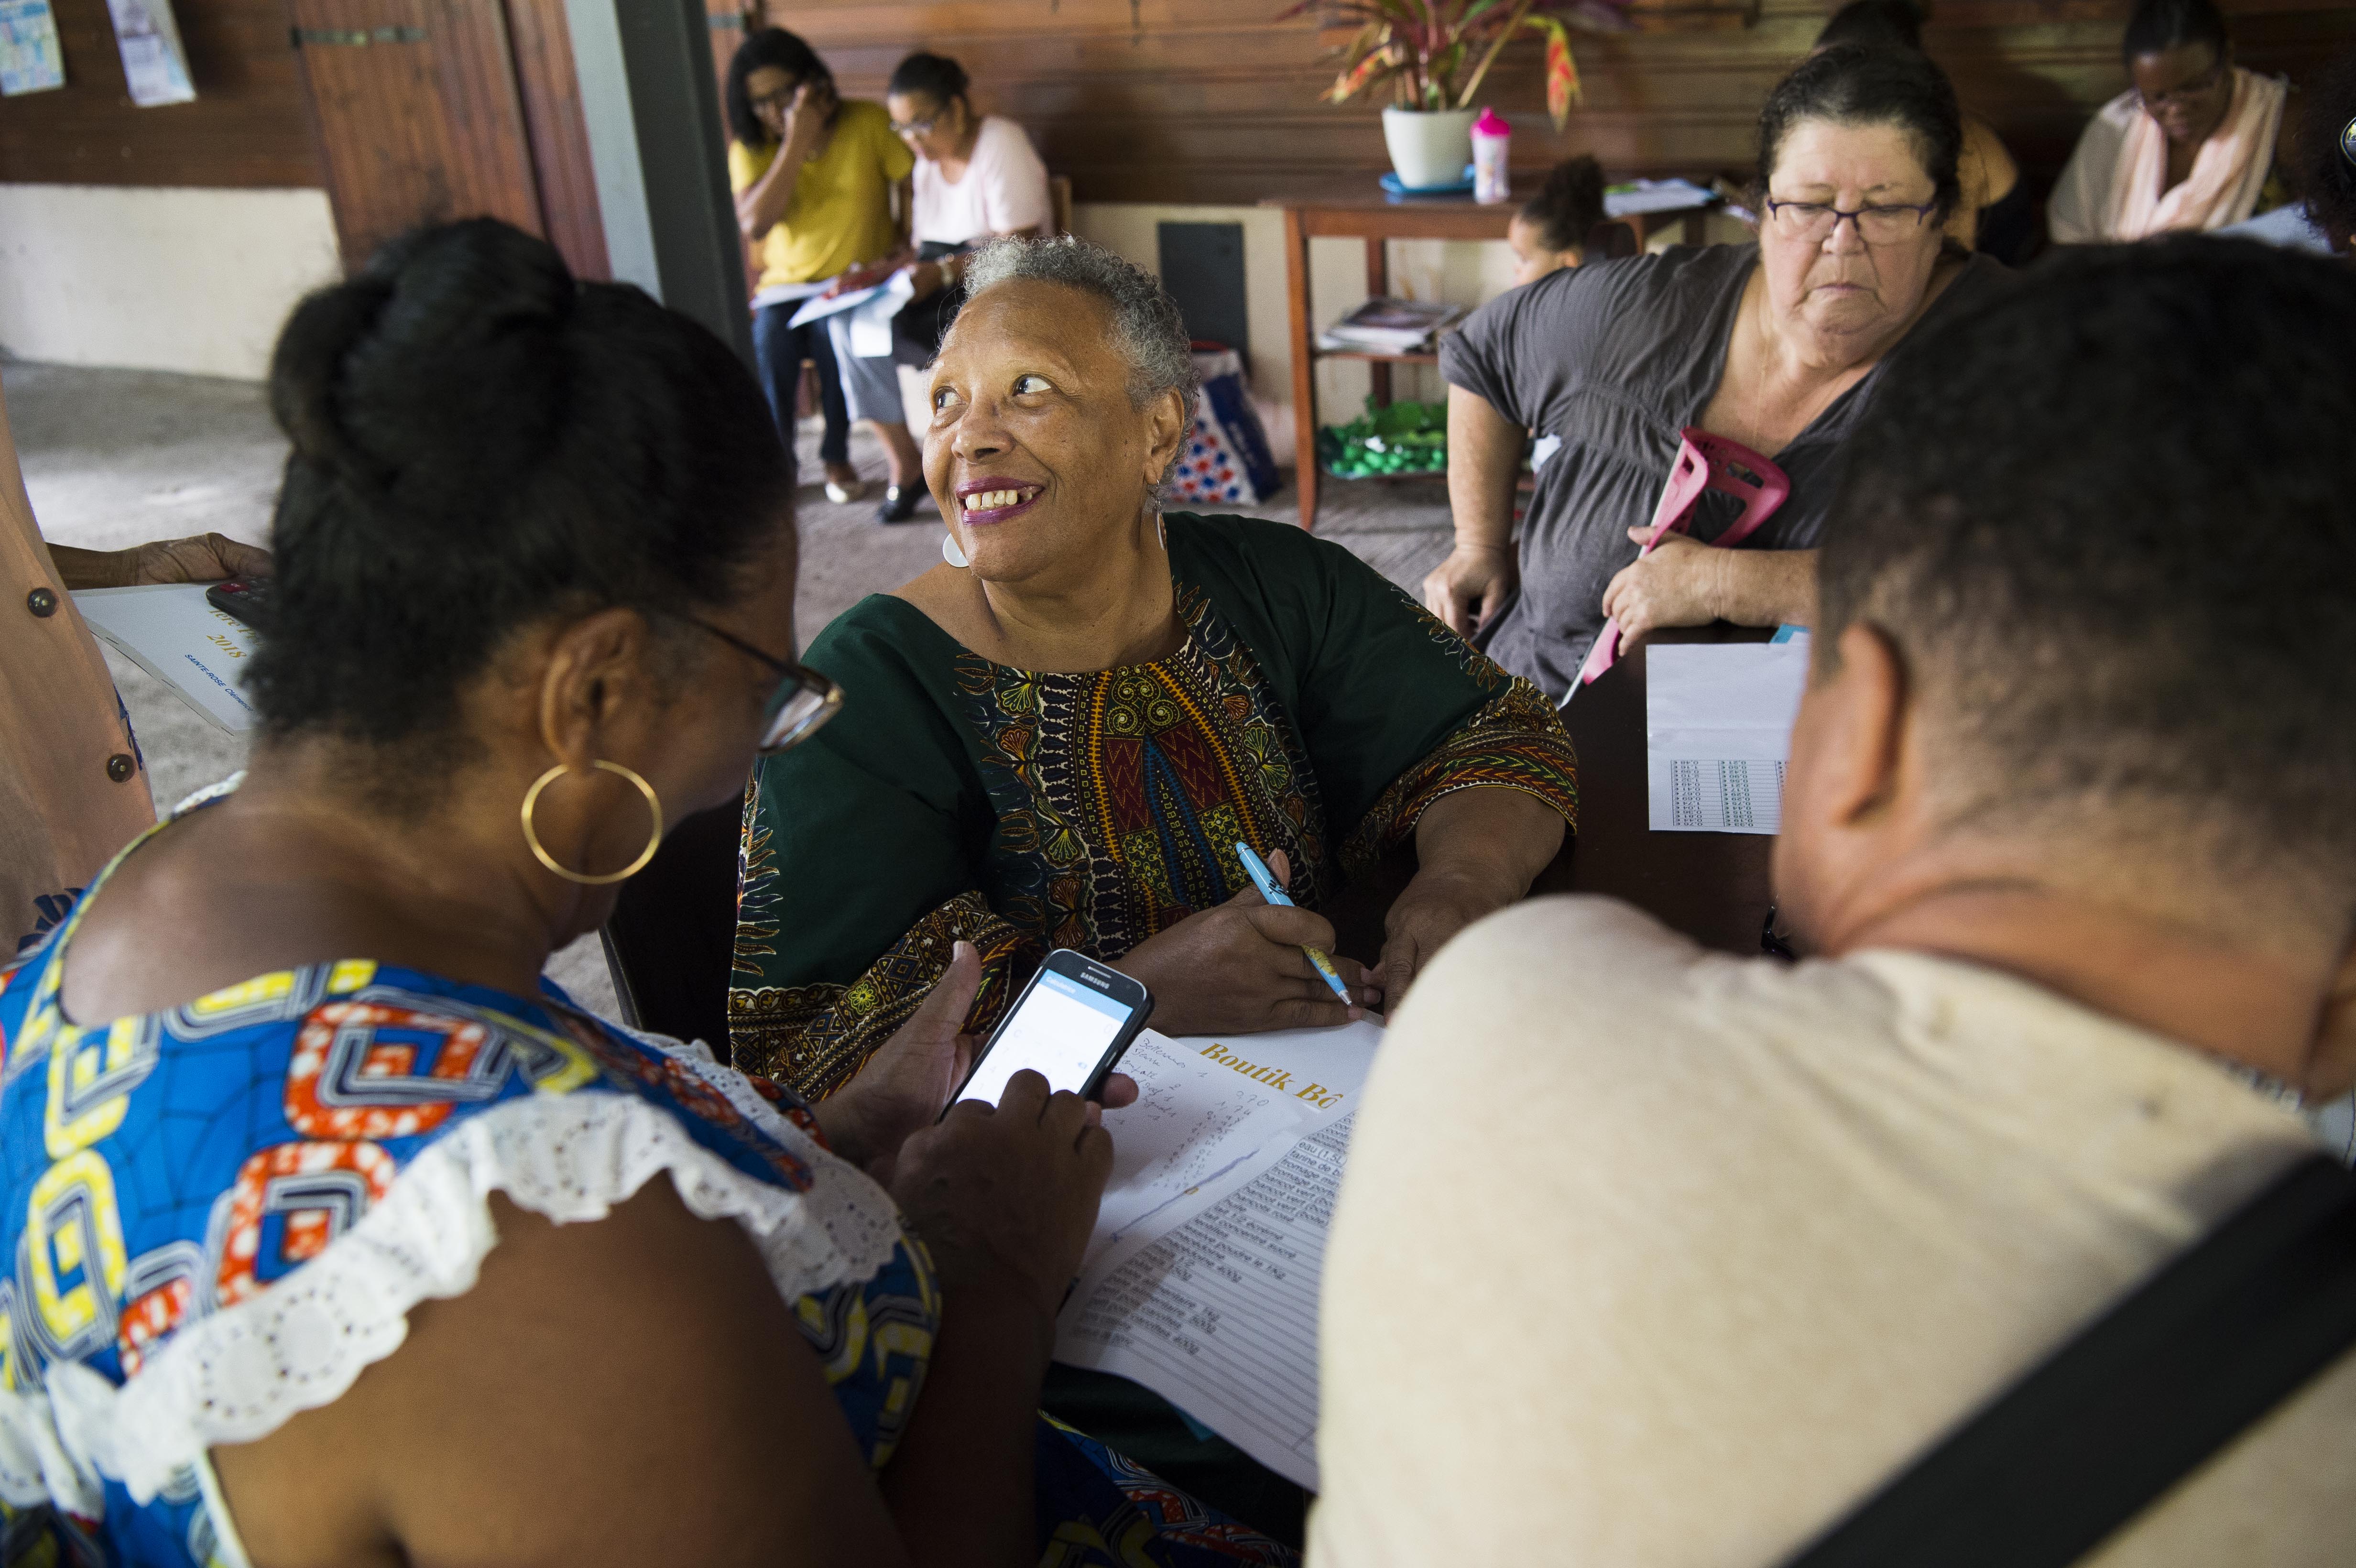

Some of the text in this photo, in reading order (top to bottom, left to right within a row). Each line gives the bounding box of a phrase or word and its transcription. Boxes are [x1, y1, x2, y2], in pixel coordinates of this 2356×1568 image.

[207, 634, 247, 658] 2018
[185, 654, 253, 711] SAINTE-ROSE Clémence
[1080, 972, 1110, 989] SAMSUNG
[1200, 1043, 1295, 1090] Boutik
[1298, 1142, 1318, 1154] eau
[1281, 1159, 1320, 1178] fromage
[1290, 1150, 1317, 1165] farine
[1318, 1164, 1331, 1172] de
[1271, 1166, 1310, 1186] fromage
